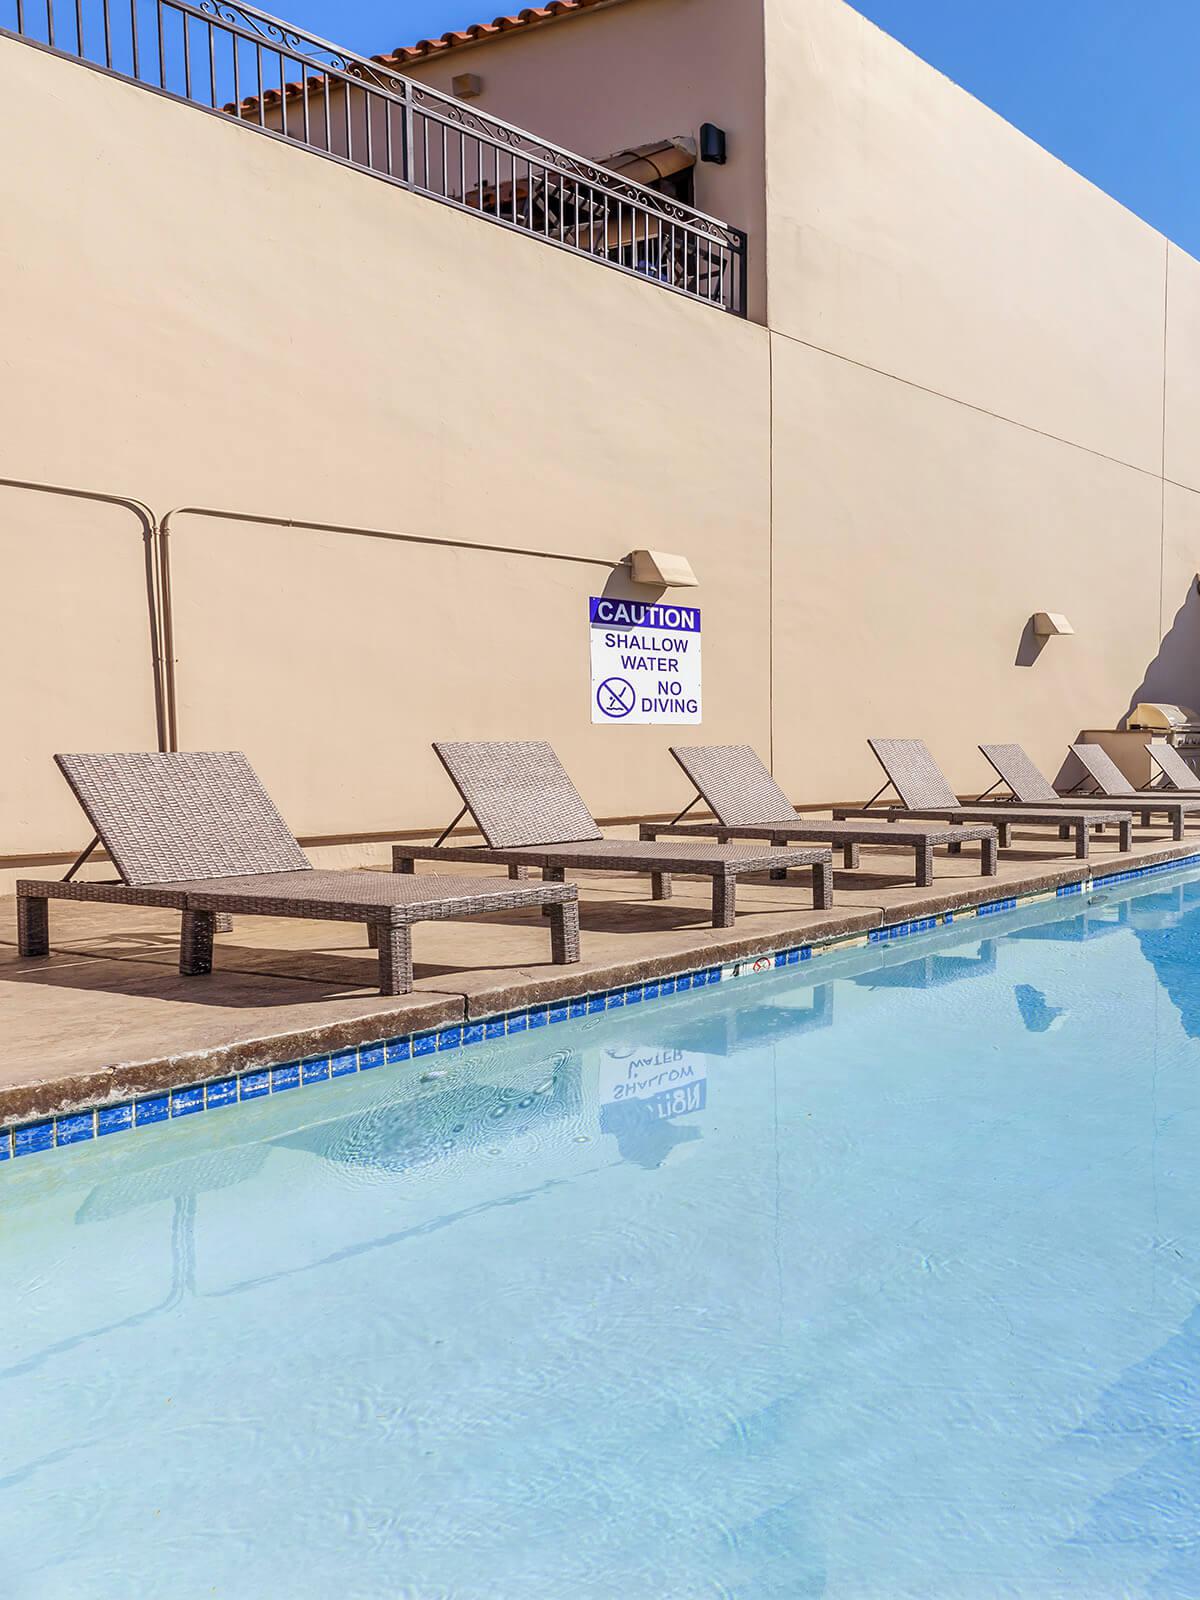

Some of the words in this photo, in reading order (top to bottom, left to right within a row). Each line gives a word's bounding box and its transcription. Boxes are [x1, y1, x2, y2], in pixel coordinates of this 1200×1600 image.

[598, 601, 695, 629] CAUTION
[605, 633, 689, 653] SHALLOW
[621, 655, 679, 672] WATER
[658, 681, 682, 696] NO
[641, 698, 698, 713] DIVING
